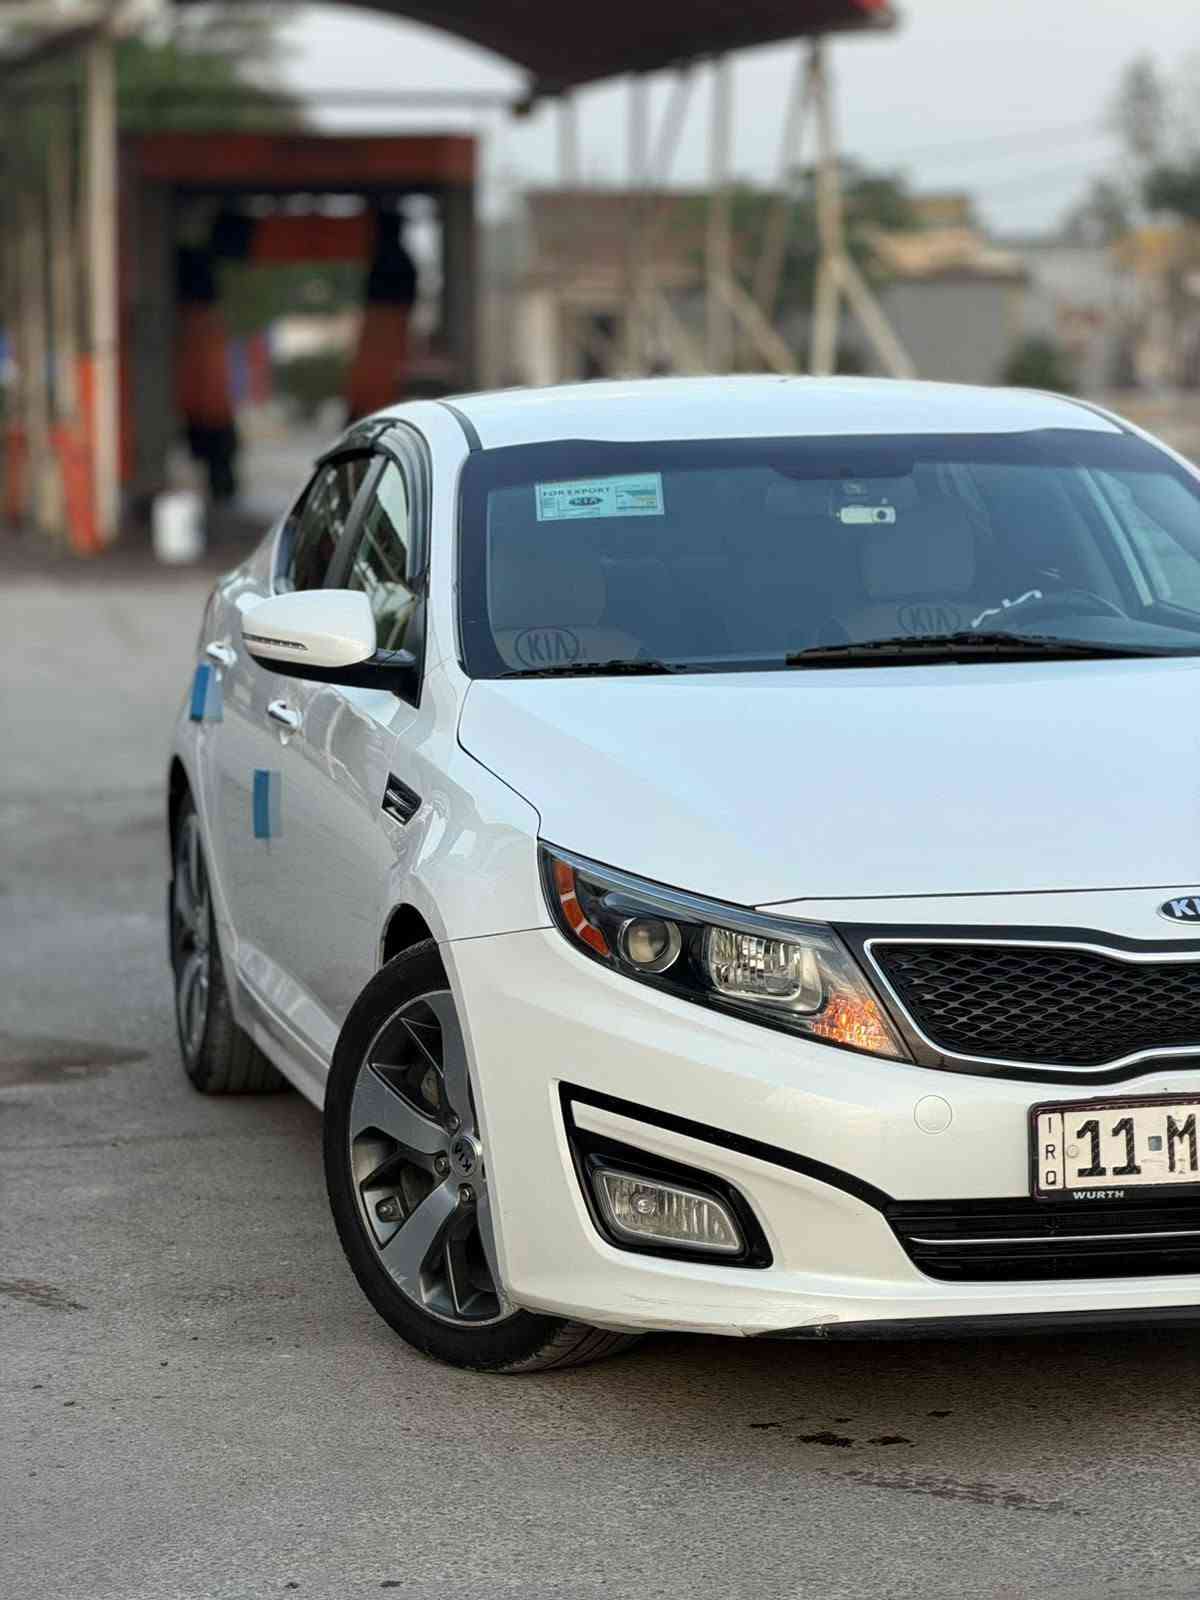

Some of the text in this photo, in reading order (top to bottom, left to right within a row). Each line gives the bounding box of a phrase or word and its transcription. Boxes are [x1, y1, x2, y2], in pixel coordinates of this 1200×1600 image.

[543, 487, 609, 497] FOR EXPORT
[527, 631, 573, 661] KIA
[1076, 1117, 1142, 1177] 11
[1073, 1190, 1125, 1200] WURTH
